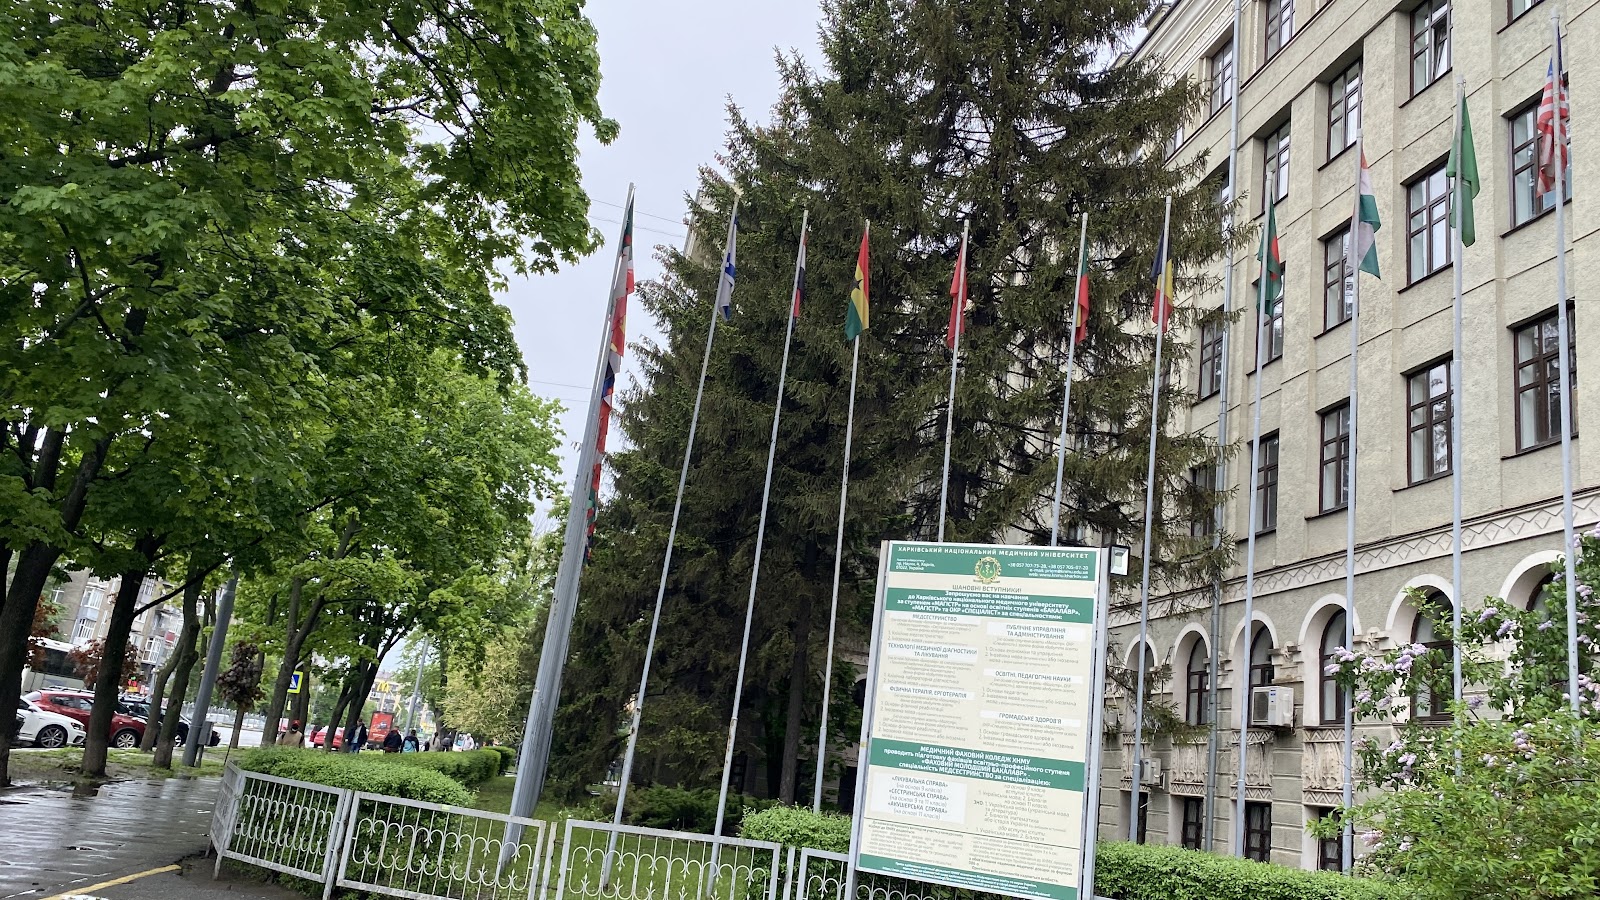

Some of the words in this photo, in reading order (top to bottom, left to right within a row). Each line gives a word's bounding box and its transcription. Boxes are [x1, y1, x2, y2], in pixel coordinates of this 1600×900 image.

[1029, 600, 1068, 608] університету
[1014, 631, 1063, 639] АДМІНІСТРУВАННЯ
[942, 646, 976, 654] ДІАГНОСТИКИ
[1017, 672, 1051, 680] ПЕДАГОГІЧНІ
[998, 712, 1033, 721] ГРОМАДСЬКЕ
[920, 745, 953, 755] МЕДИЧНИЙ
[954, 749, 983, 759] ФАХОВИЙ
[984, 753, 1011, 762] КОЛЕДЖ
[1012, 756, 1030, 764] ХНМУ
[883, 748, 914, 757] проводить
[914, 752, 944, 761] підготовку
[946, 756, 972, 764] фахівців
[1044, 767, 1070, 776] ступеня
[921, 758, 952, 767] «ФАХОВИЙ
[954, 762, 990, 772] МОЛОДШИЙ
[898, 761, 938, 771] спеціальність
[939, 766, 993, 778] МЕДСЕСТРИНСТВО
[891, 775, 924, 784] «ЛІКУВАЛЬНА
[888, 787, 925, 797] «СЕСТРИНСЬКА
[926, 792, 949, 800] СПРАВА»
[887, 800, 923, 810] «АКУШЕРСЬКА
[925, 805, 947, 814] СПРАВА»
